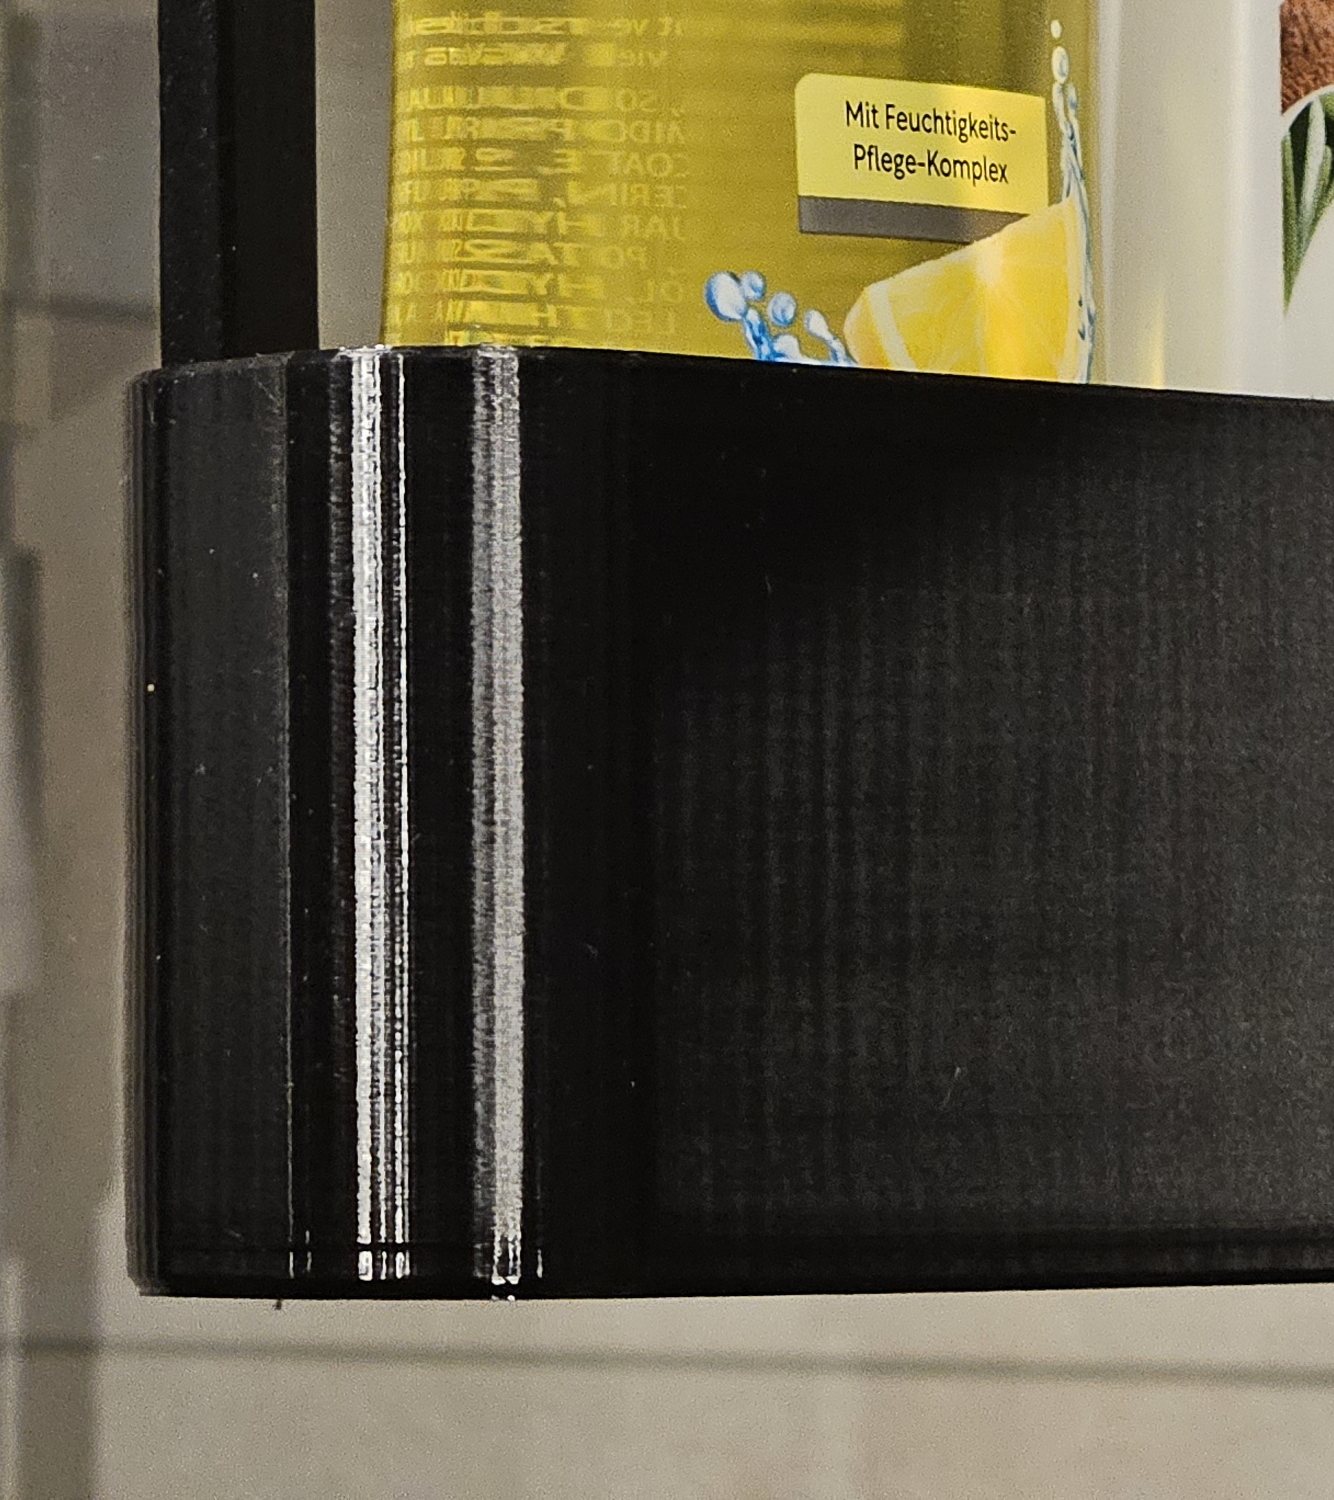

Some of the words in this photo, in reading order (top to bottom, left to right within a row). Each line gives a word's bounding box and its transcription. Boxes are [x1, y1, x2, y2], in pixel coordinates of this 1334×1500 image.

[845, 100, 880, 130] Mit
[884, 103, 1017, 144] Feuchtigkeits-
[853, 142, 1009, 187] Pflege-Komplex
